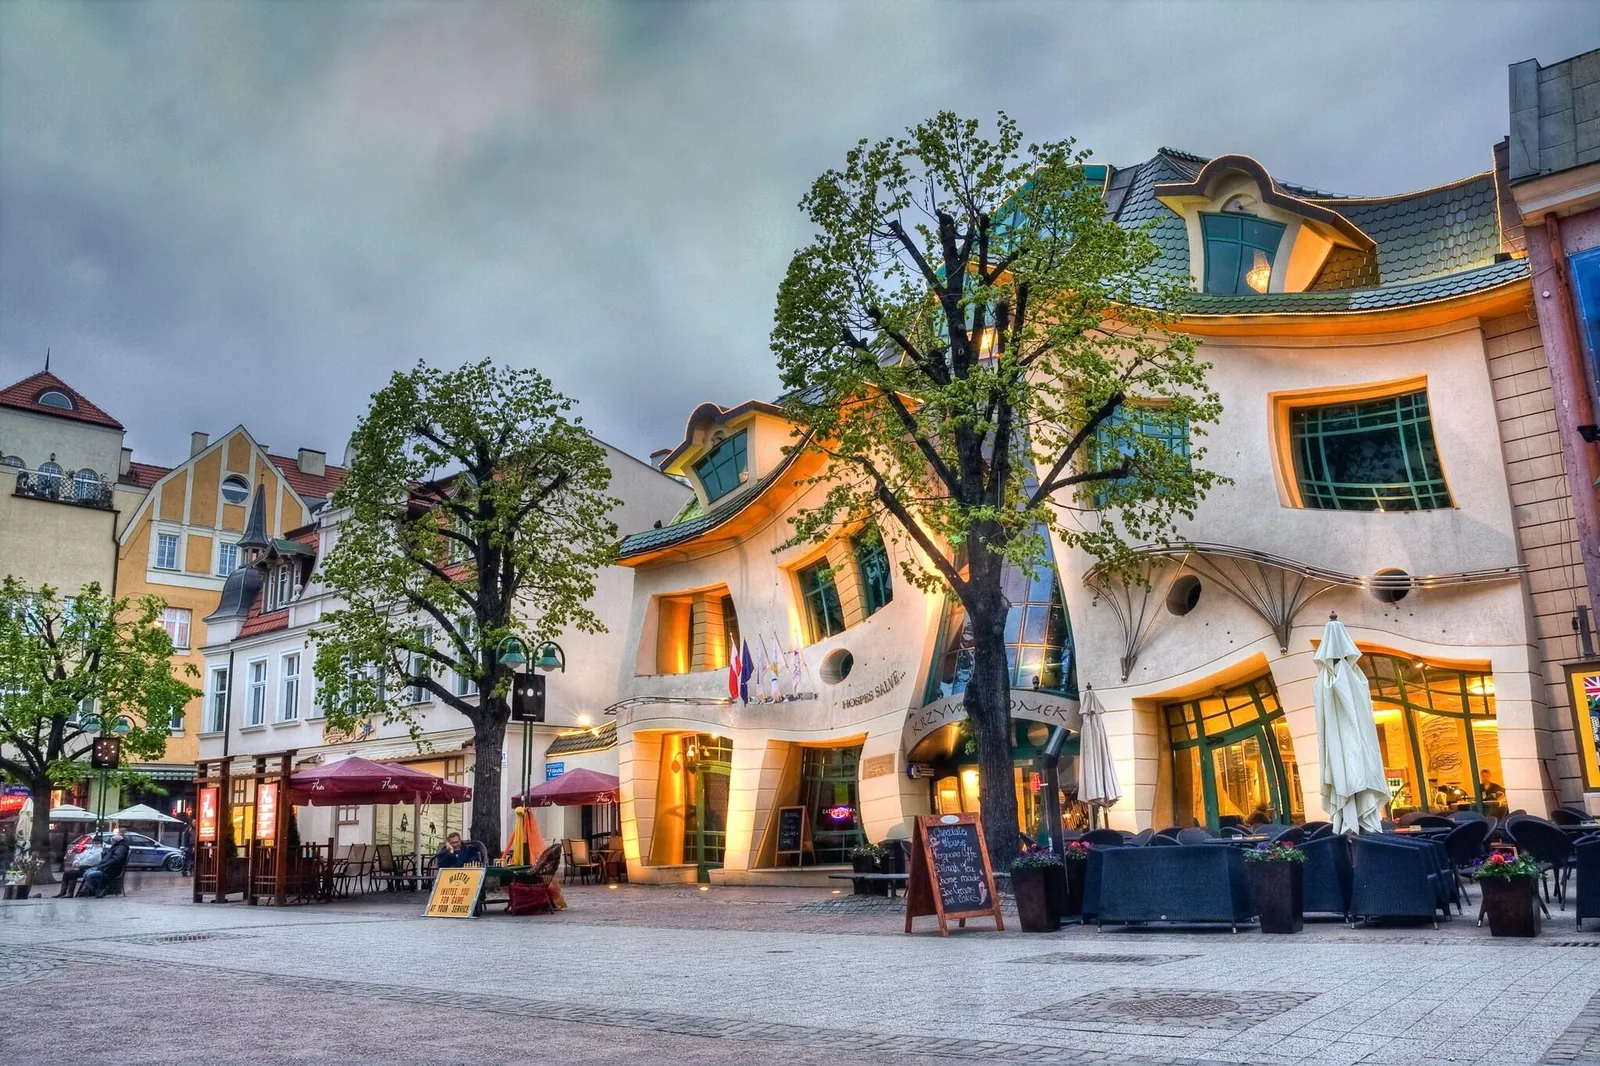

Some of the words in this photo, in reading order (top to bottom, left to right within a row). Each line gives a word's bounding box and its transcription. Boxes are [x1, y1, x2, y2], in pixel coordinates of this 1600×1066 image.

[842, 690, 874, 709] HOSPES
[912, 702, 965, 736] KRZYW
[449, 873, 470, 884] MAESTRO
[440, 896, 449, 904] FOR
[452, 905, 469, 913] SERVICE
